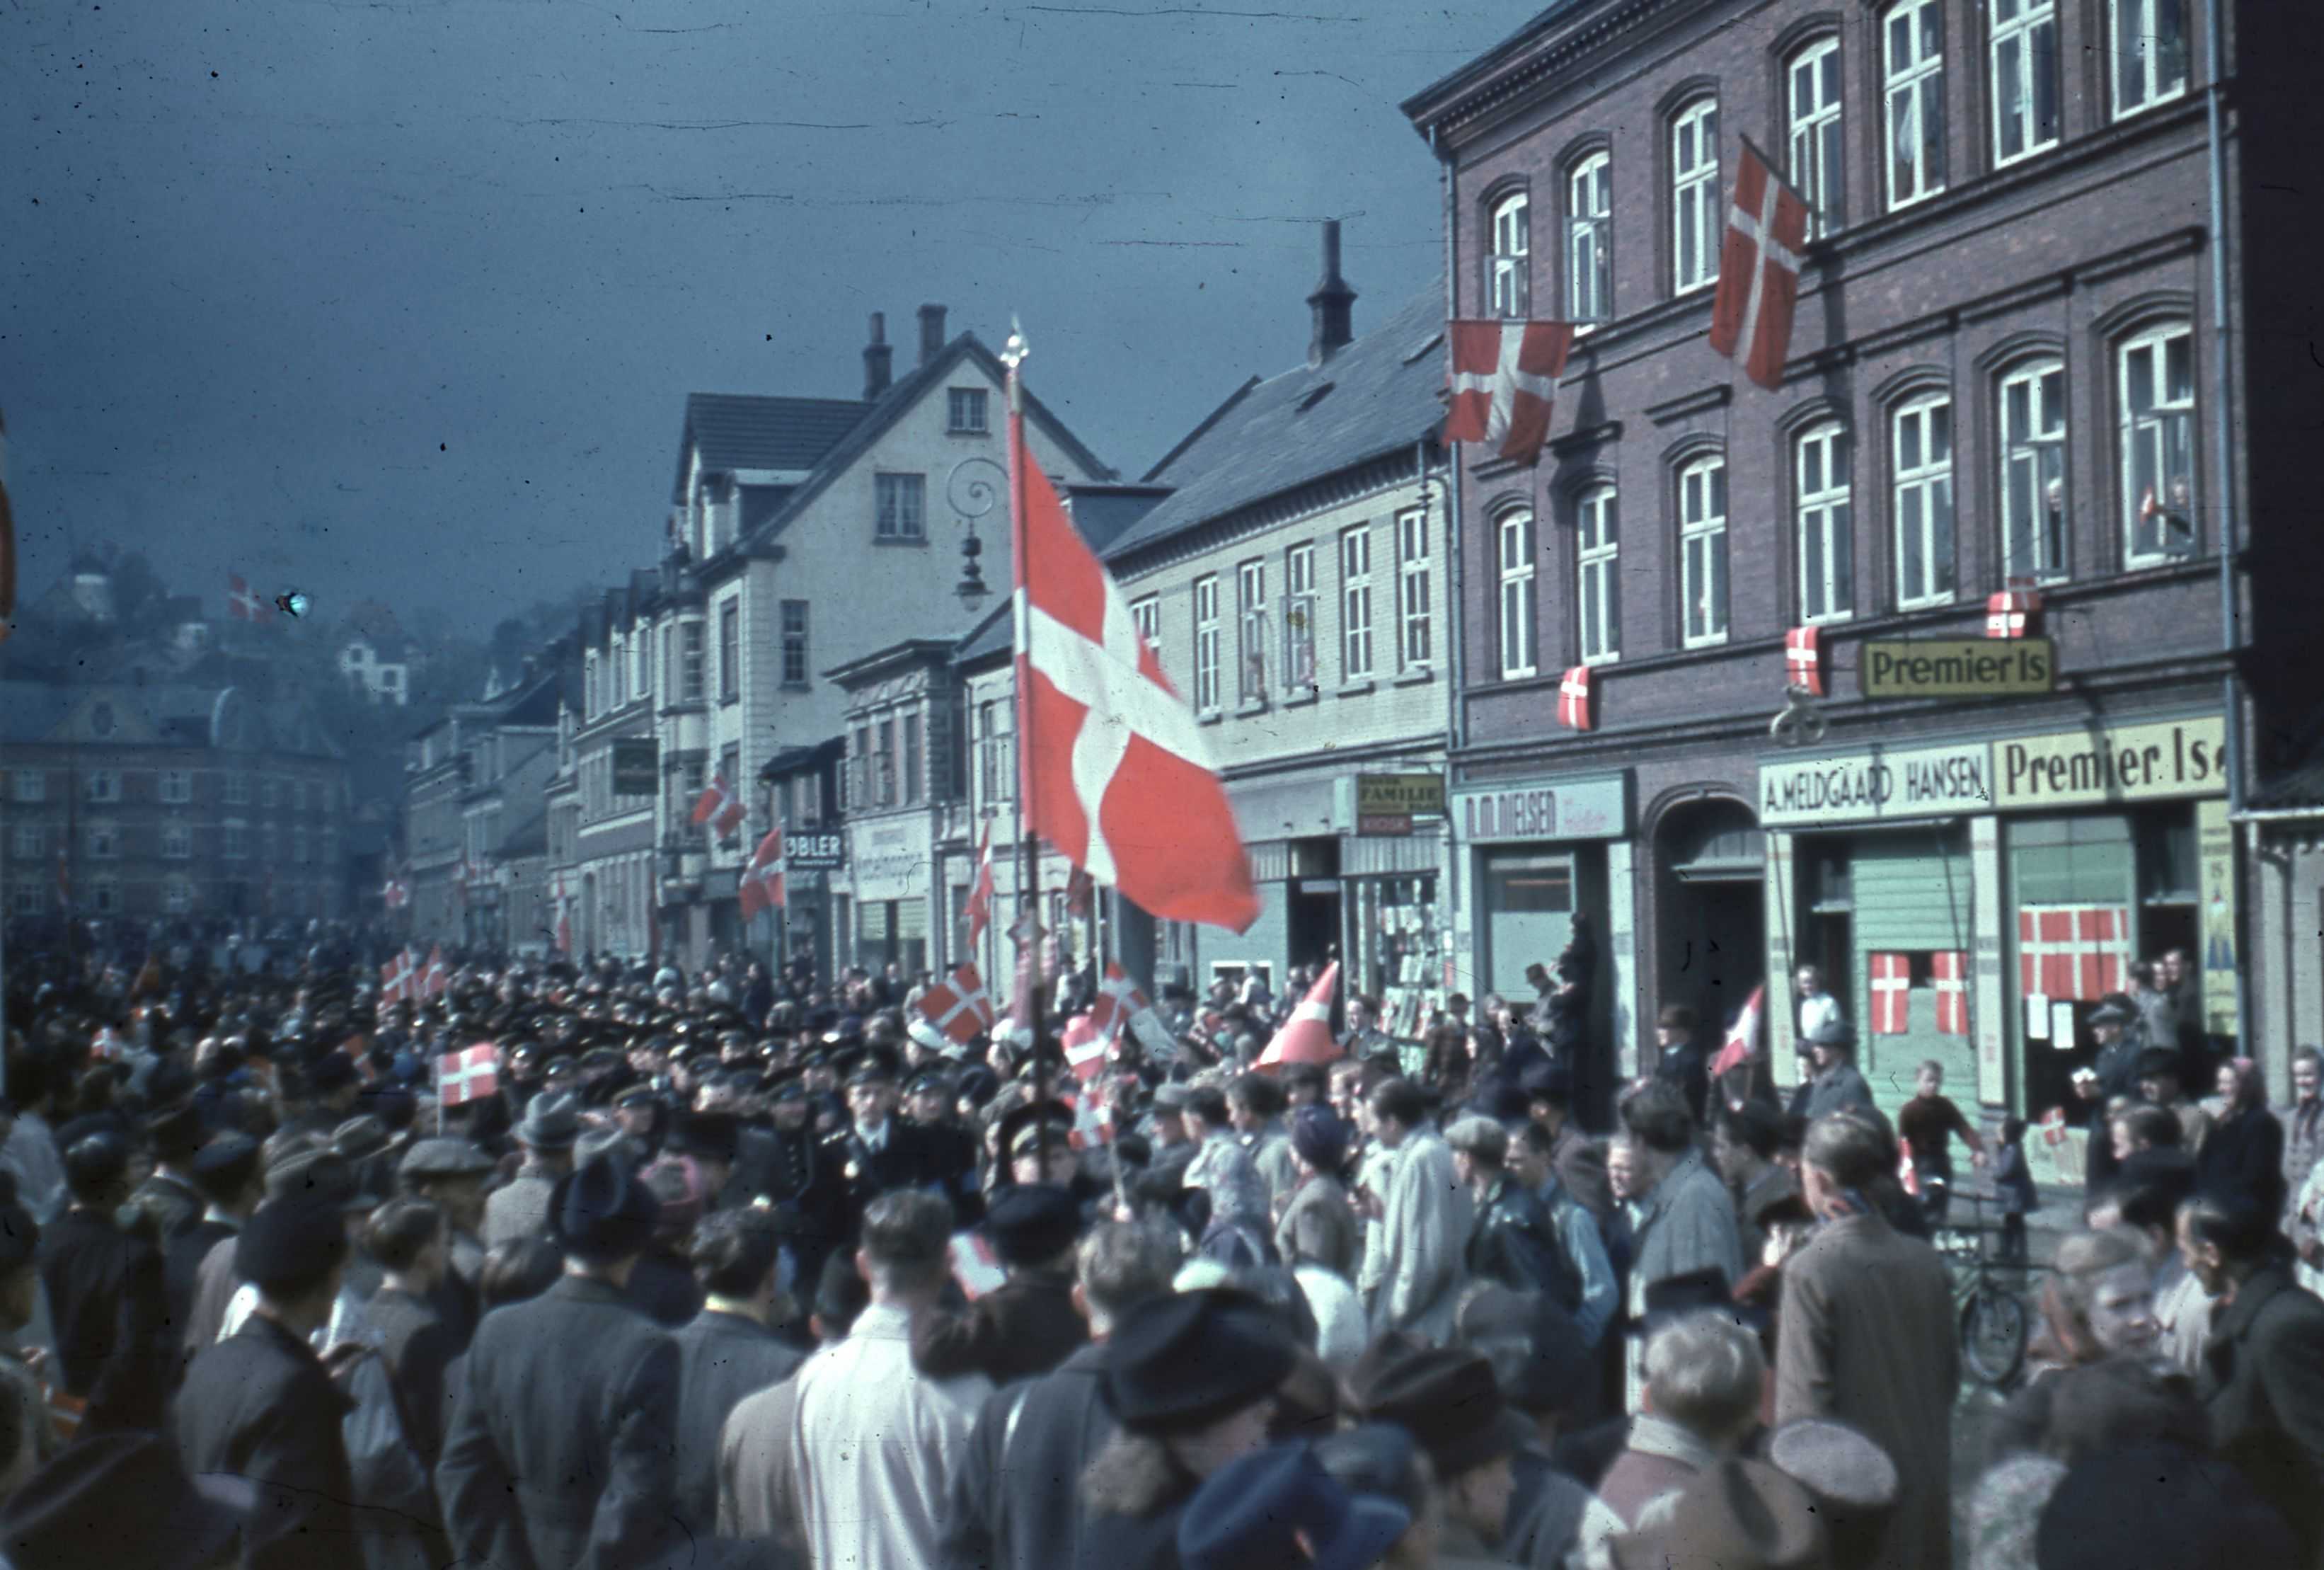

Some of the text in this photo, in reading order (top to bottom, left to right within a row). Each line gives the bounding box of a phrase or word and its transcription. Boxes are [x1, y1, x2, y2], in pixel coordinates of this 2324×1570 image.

[1873, 647, 2045, 684] Premier Is
[1905, 755, 1981, 802] HANSEN
[2006, 738, 2161, 796] Premier
[1360, 787, 1439, 801] FAMILIE
